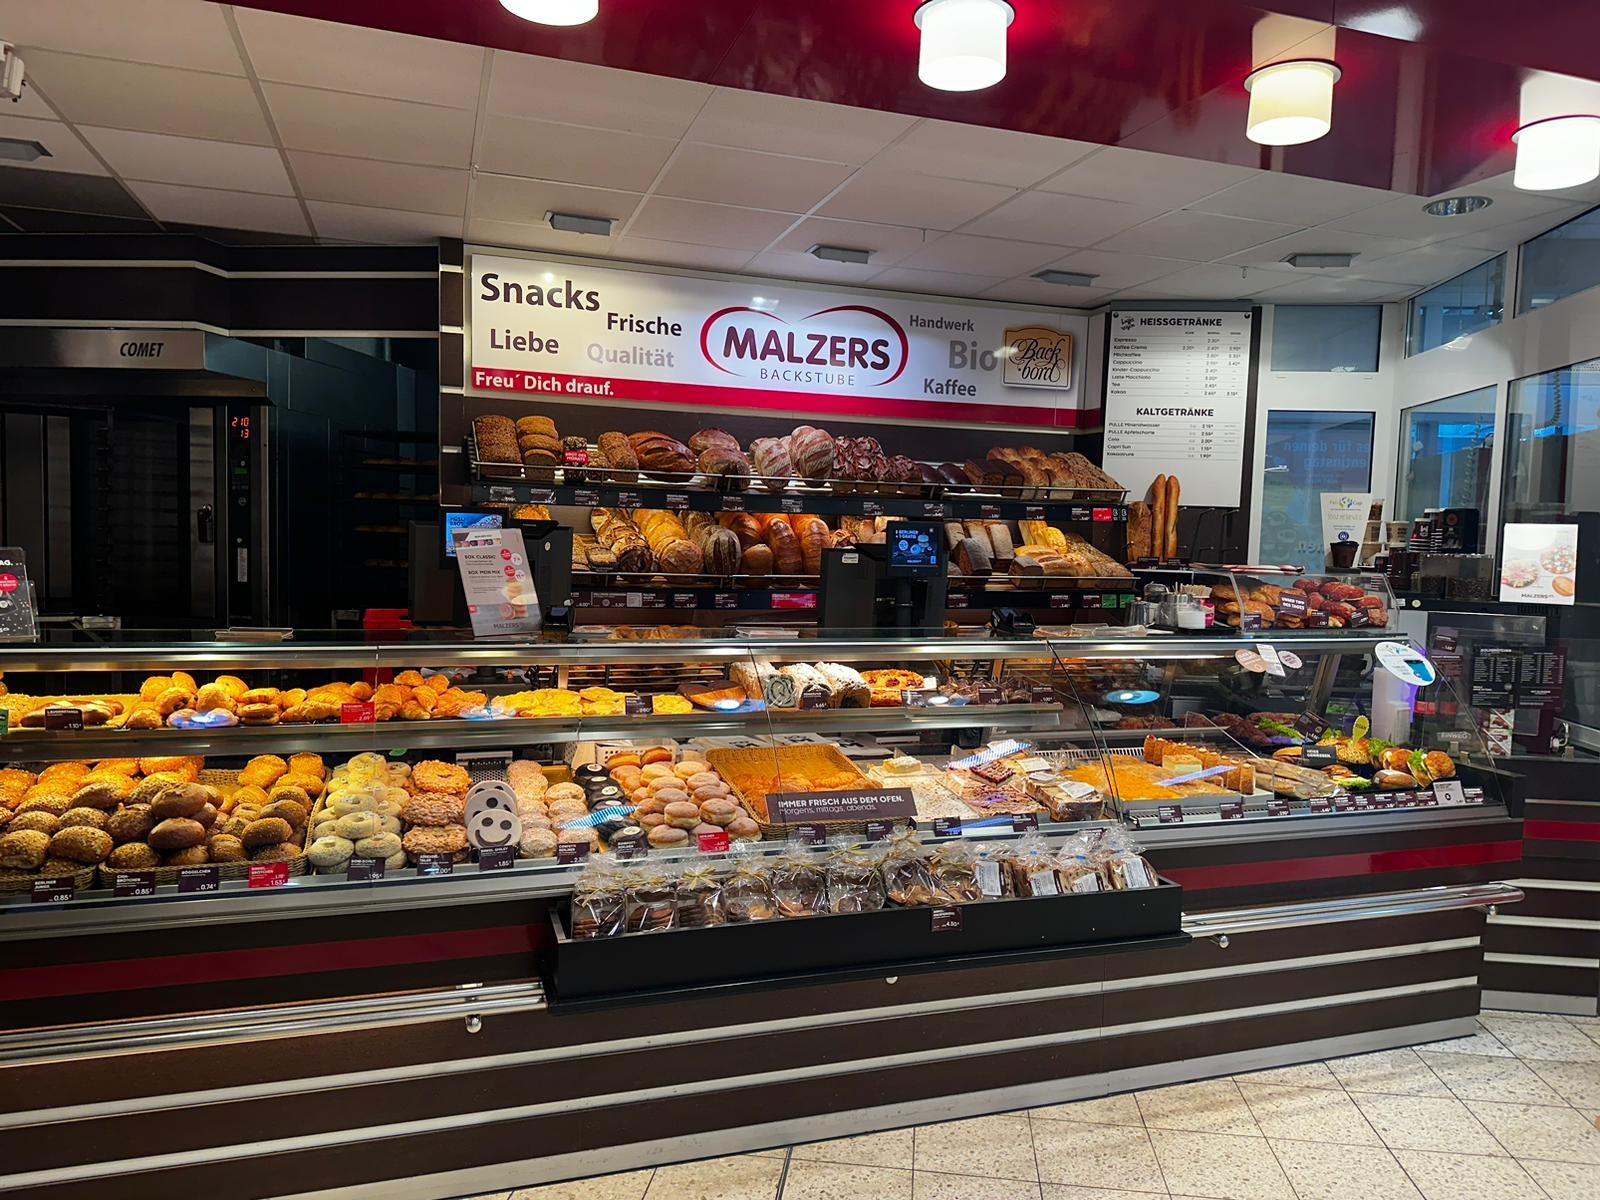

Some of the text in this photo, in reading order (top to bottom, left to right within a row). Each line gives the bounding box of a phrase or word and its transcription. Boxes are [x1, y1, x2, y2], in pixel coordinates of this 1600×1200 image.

[480, 272, 600, 311] Snacks
[607, 313, 682, 337] Frische
[909, 314, 975, 332] Handwerk
[1140, 316, 1223, 327] HEISSGETRÄNKE
[120, 343, 164, 357] COMET
[490, 328, 559, 354] Liebe
[723, 325, 891, 371] MALZERS
[586, 343, 675, 368] Qualität
[949, 340, 999, 372] Bio
[524, 375, 562, 392] Dich
[565, 378, 614, 396] drauf.
[760, 369, 856, 386] BACKSTUBE
[924, 378, 978, 397] Kaffee
[1136, 407, 1214, 417] KALTGETRÄNKE
[231, 417, 250, 427] 210
[240, 428, 250, 439] 13
[778, 795, 905, 809] IMMER FRISCH AUS DEM OFEN.
